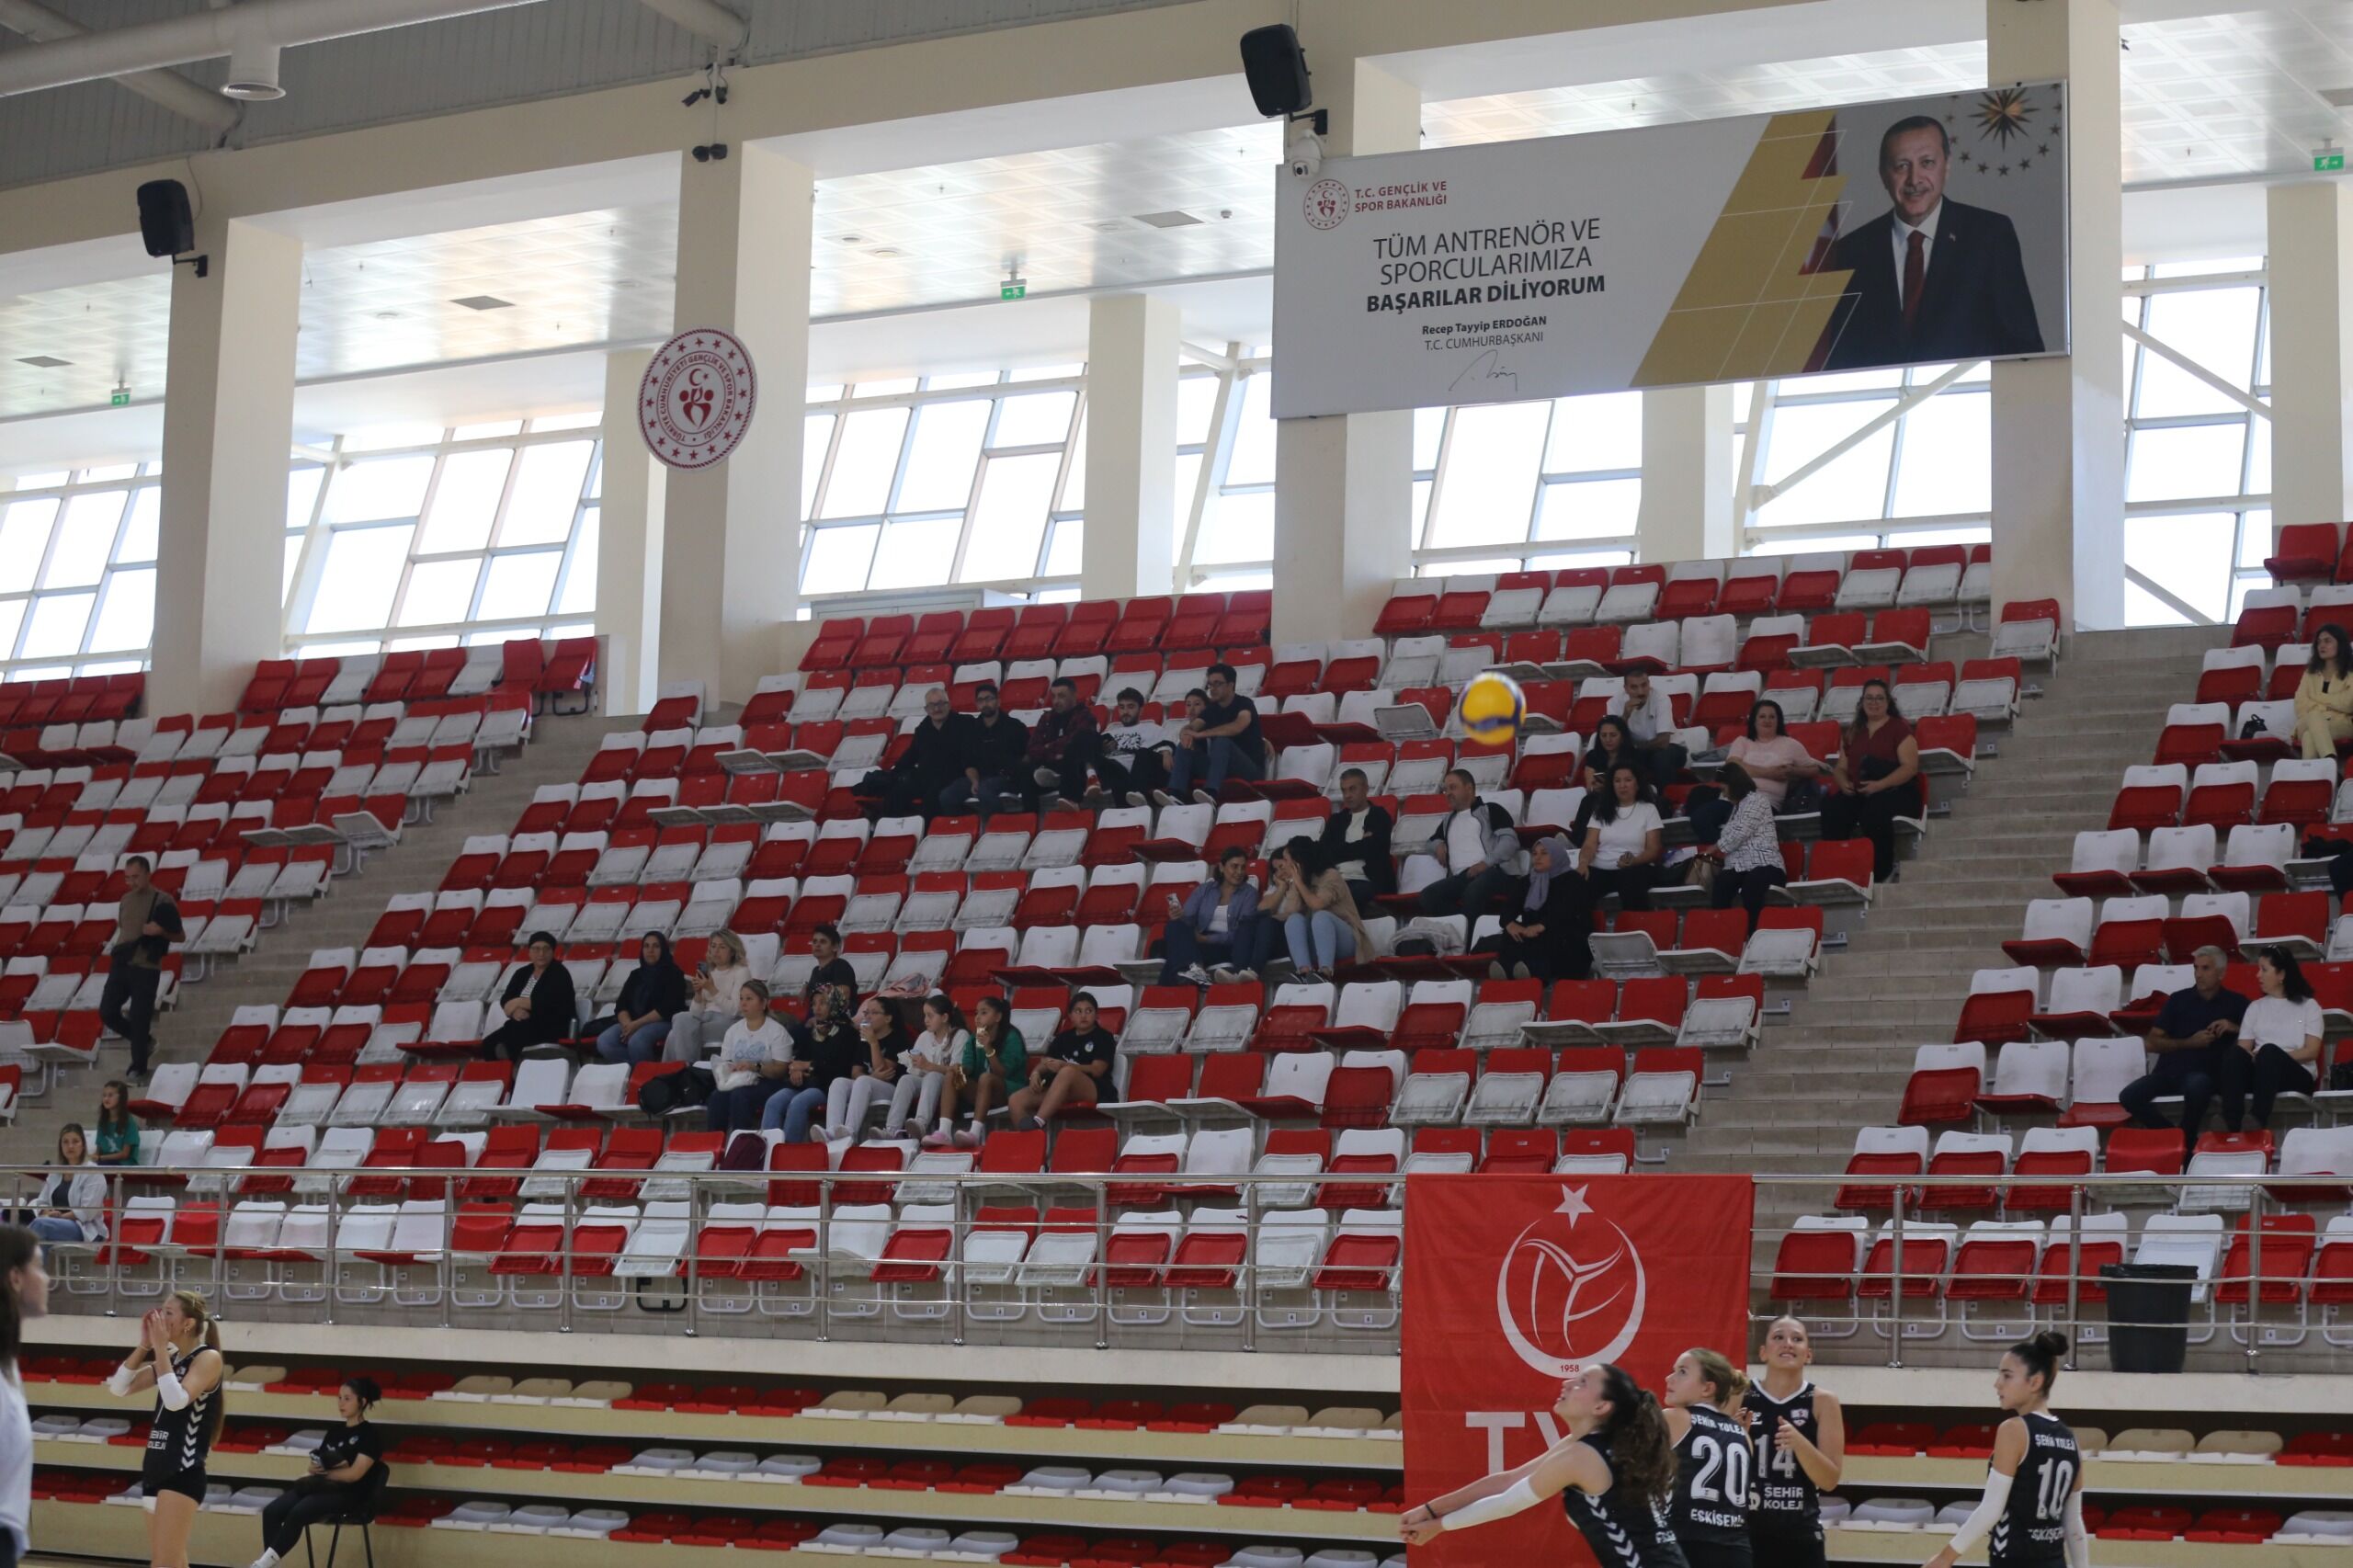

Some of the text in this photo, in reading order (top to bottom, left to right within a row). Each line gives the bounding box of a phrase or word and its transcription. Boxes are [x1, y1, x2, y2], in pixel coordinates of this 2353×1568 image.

[1355, 181, 1447, 199] T.C. GENÇLİK VE
[1355, 195, 1447, 212] SPOR BAKANLIĞI
[1373, 218, 1600, 259] TÜM ANTRENÖR VE
[1381, 246, 1593, 286] SPORCULARIMIZA
[1367, 275, 1606, 314] BAŞARILAR DİLİYORUM
[1422, 315, 1547, 335] Recep Tayyip ERDOĞAN
[1425, 332, 1544, 350] T.C. CUMHURBAŞKANI
[1561, 1364, 1580, 1373] 1958
[1690, 1436, 1750, 1507] 20
[1755, 1434, 1797, 1479] 14
[2036, 1458, 2074, 1521] 10
